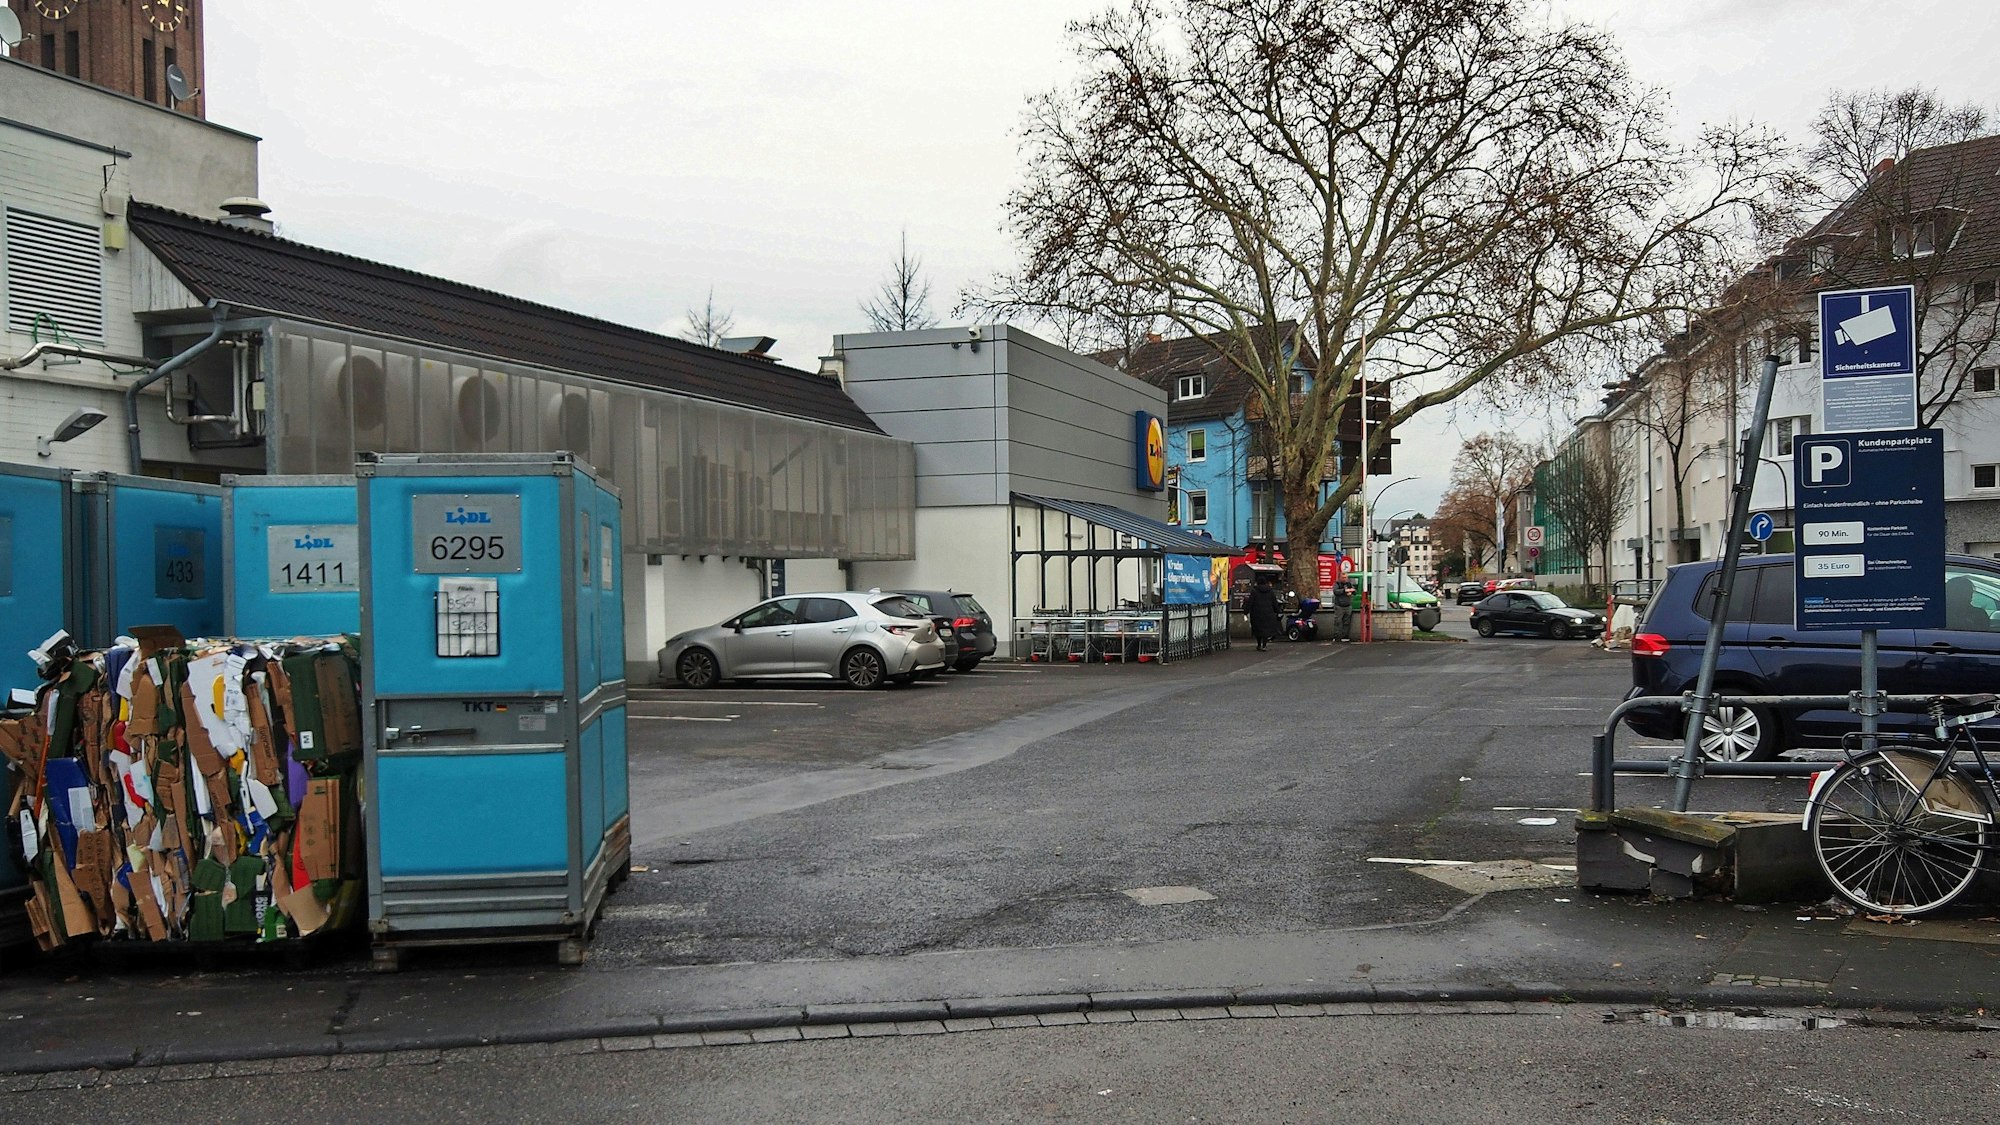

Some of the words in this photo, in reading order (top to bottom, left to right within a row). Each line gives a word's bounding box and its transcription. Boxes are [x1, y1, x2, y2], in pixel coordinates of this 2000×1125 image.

[1835, 361, 1901, 371] Sicherheitskameras
[1811, 445, 1843, 483] P
[1858, 436, 1933, 447] Kundenparkplatz
[1818, 530, 1829, 538] 90
[431, 536, 505, 560] 6295
[166, 560, 194, 583] 433
[281, 562, 343, 584] 1411
[462, 701, 494, 712] TKT
